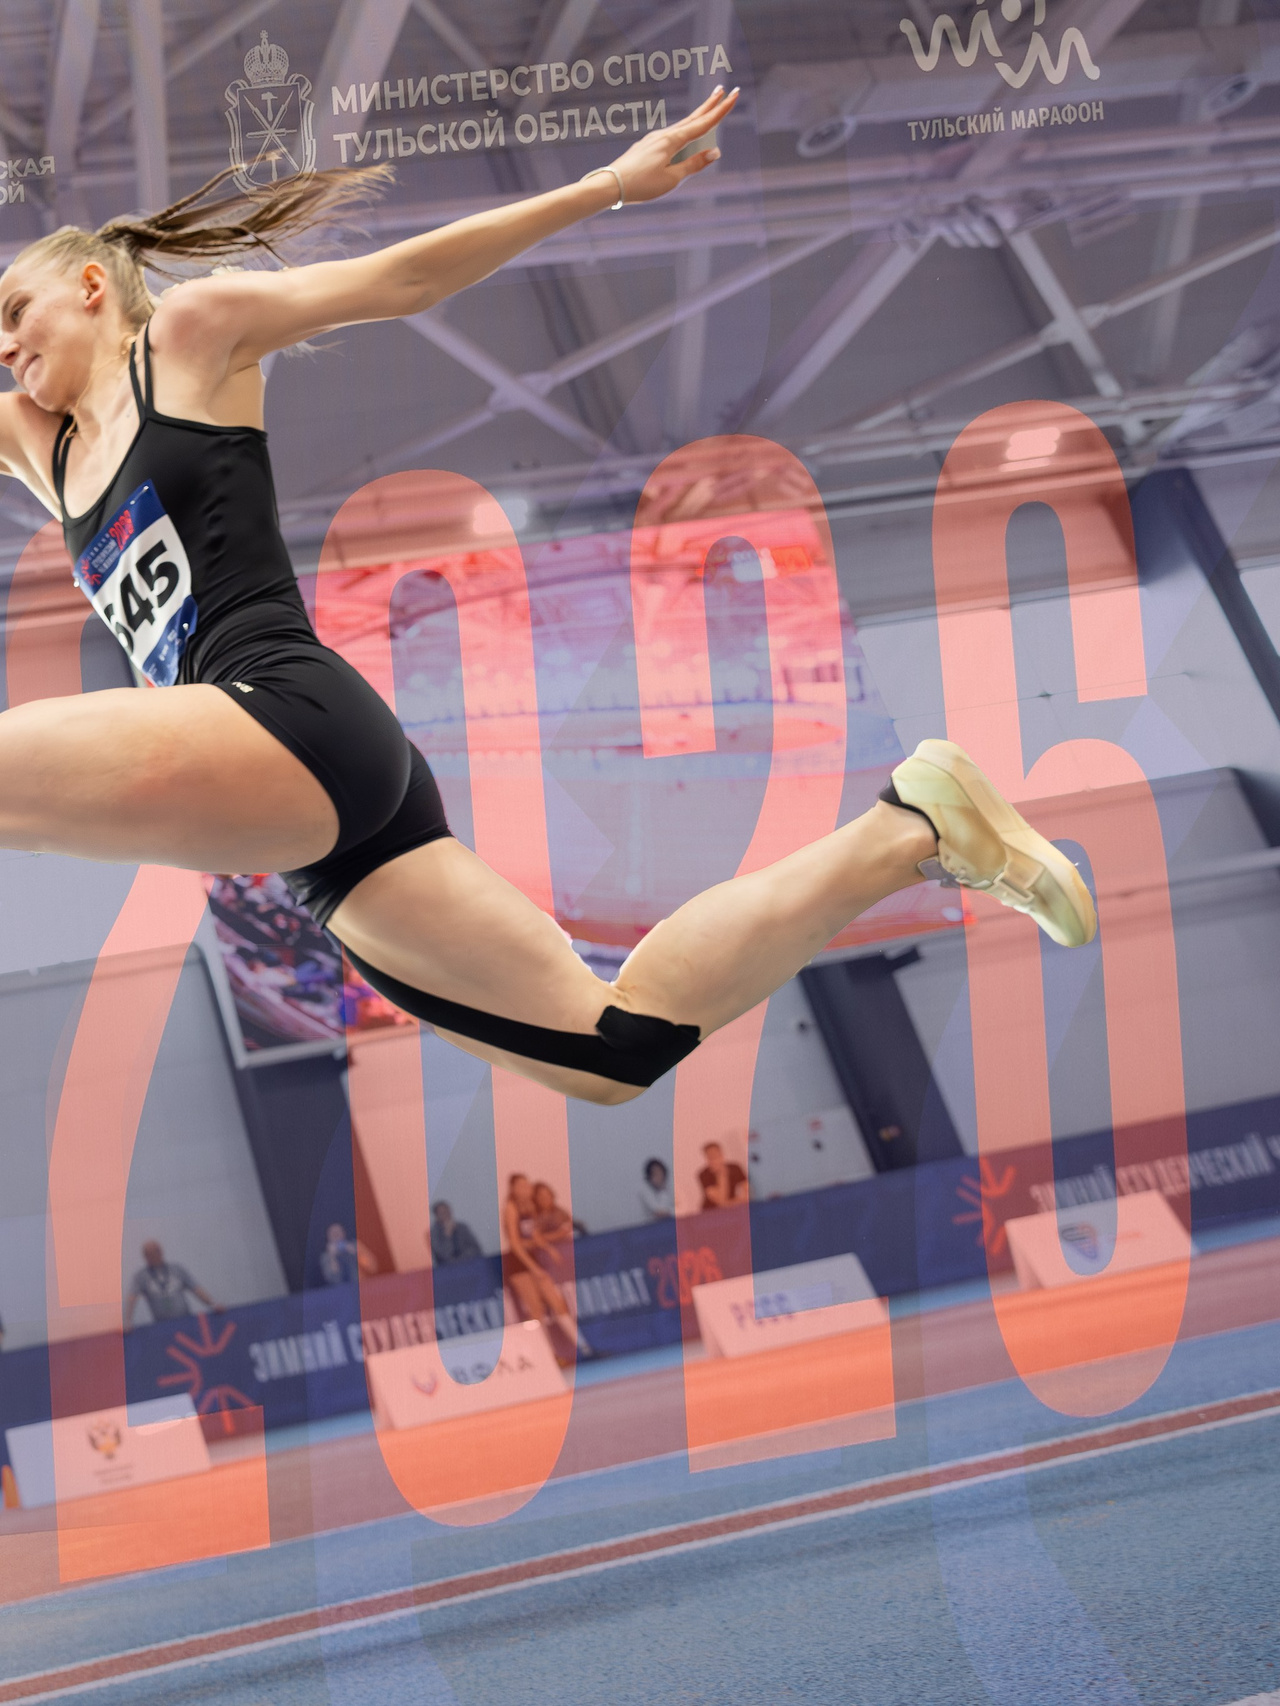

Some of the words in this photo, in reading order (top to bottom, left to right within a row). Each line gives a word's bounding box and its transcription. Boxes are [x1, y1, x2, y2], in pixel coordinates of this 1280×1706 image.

[331, 57, 595, 117] МИНИСТЕРСТВО
[602, 43, 734, 87] СПОРТА
[332, 108, 506, 166] ТУЛЬСКОЙ
[513, 98, 668, 146] ОБЛАСТИ
[907, 106, 1005, 142] ТУЛЬСКИЙ
[1011, 100, 1105, 131] МАРАФОН
